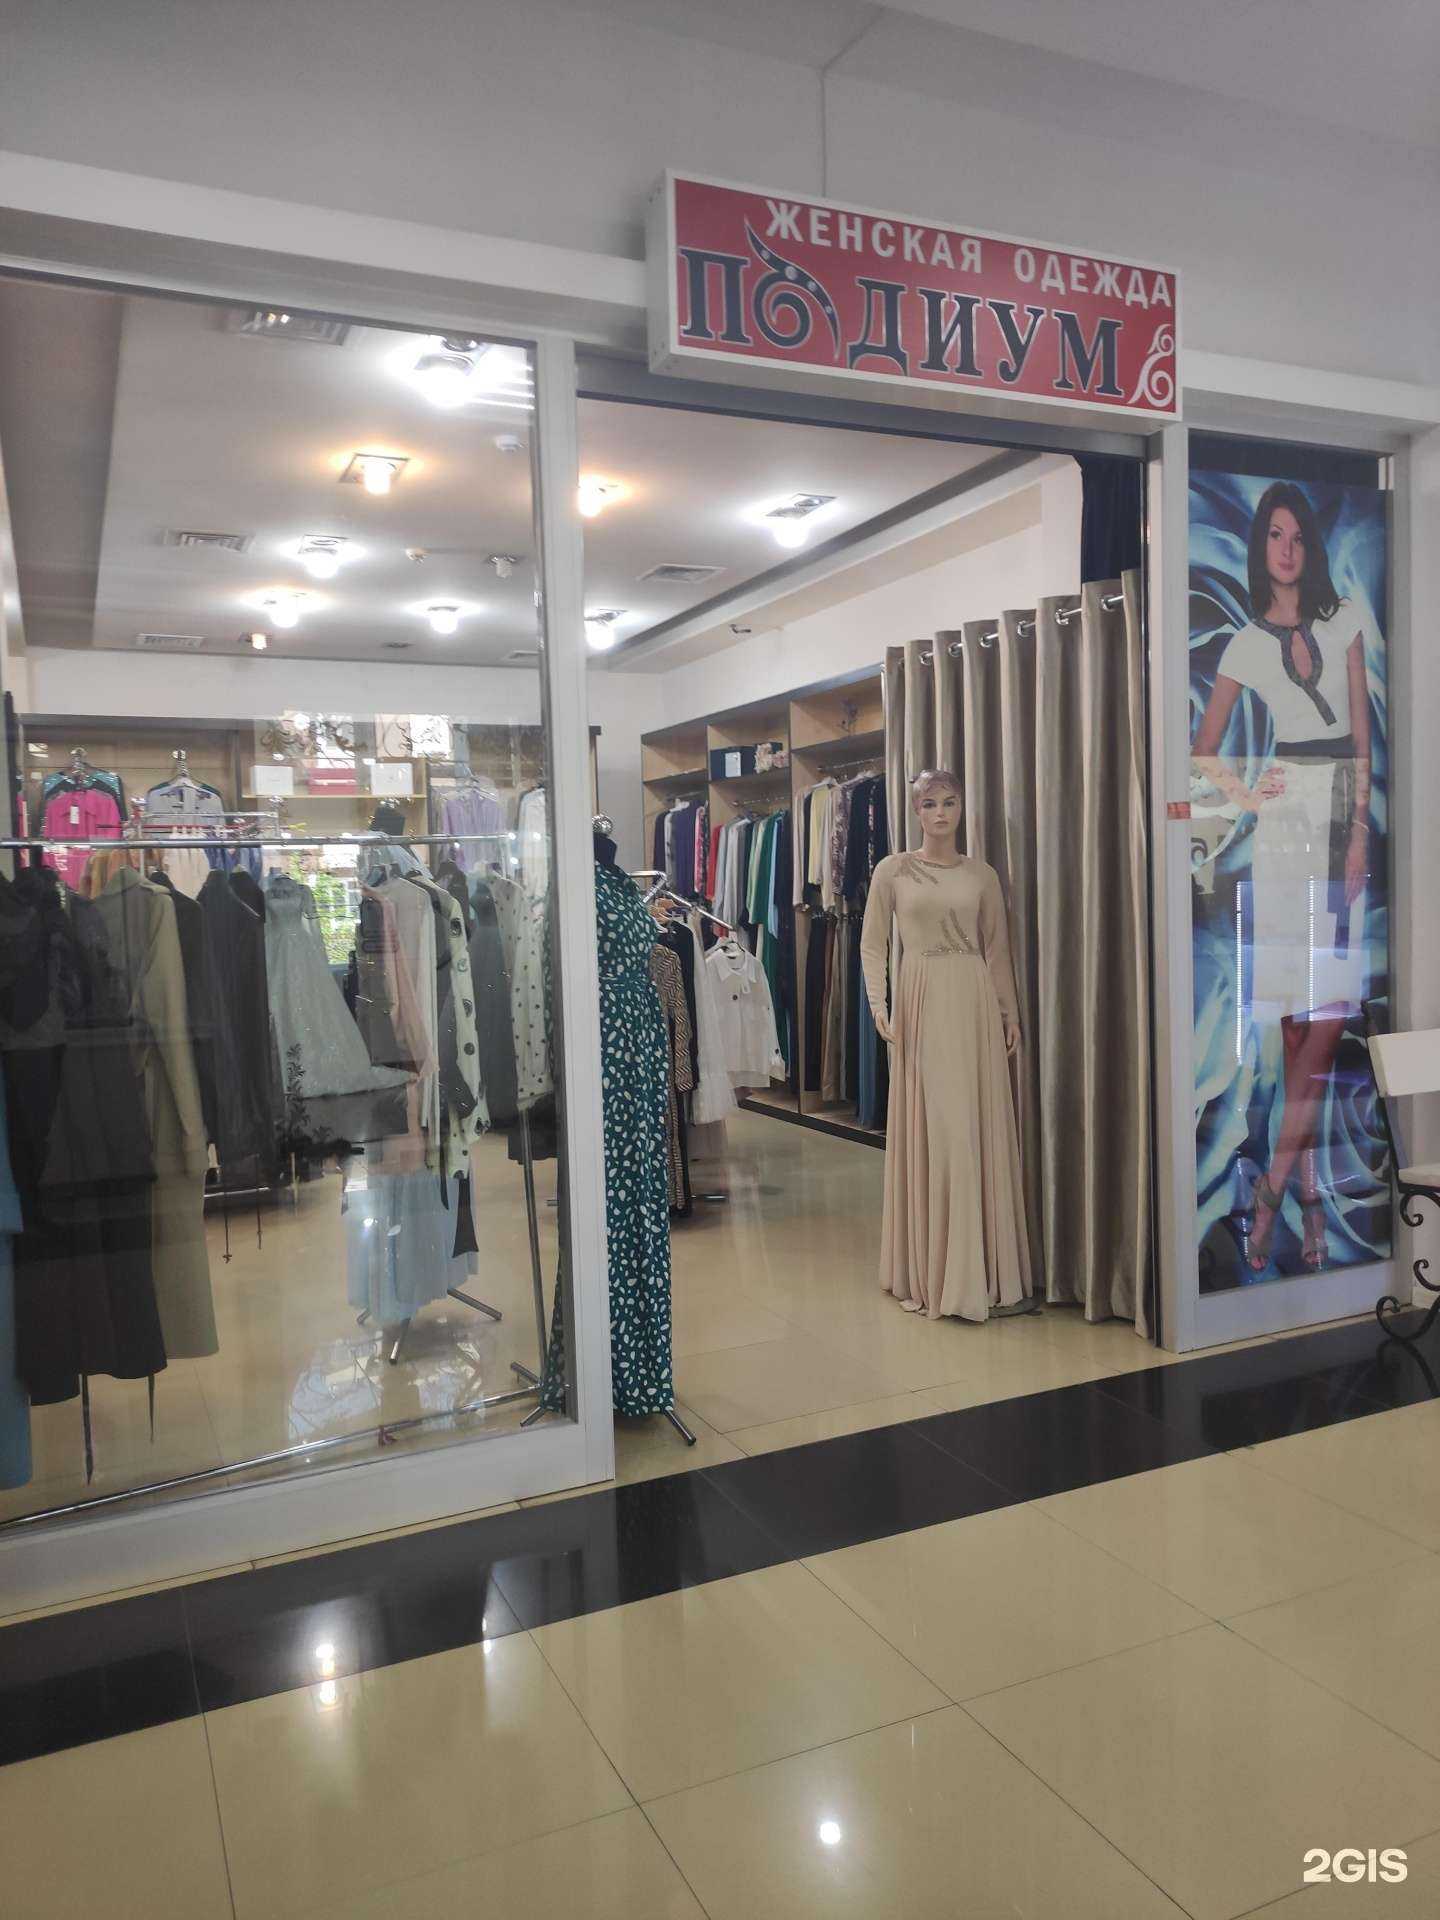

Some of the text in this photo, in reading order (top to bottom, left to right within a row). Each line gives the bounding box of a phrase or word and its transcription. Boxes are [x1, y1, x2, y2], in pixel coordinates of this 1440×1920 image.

[679, 214, 1124, 398] ПОДИУМ
[765, 199, 1172, 310] ЖЕНСКАЯ ОДЕЖДА
